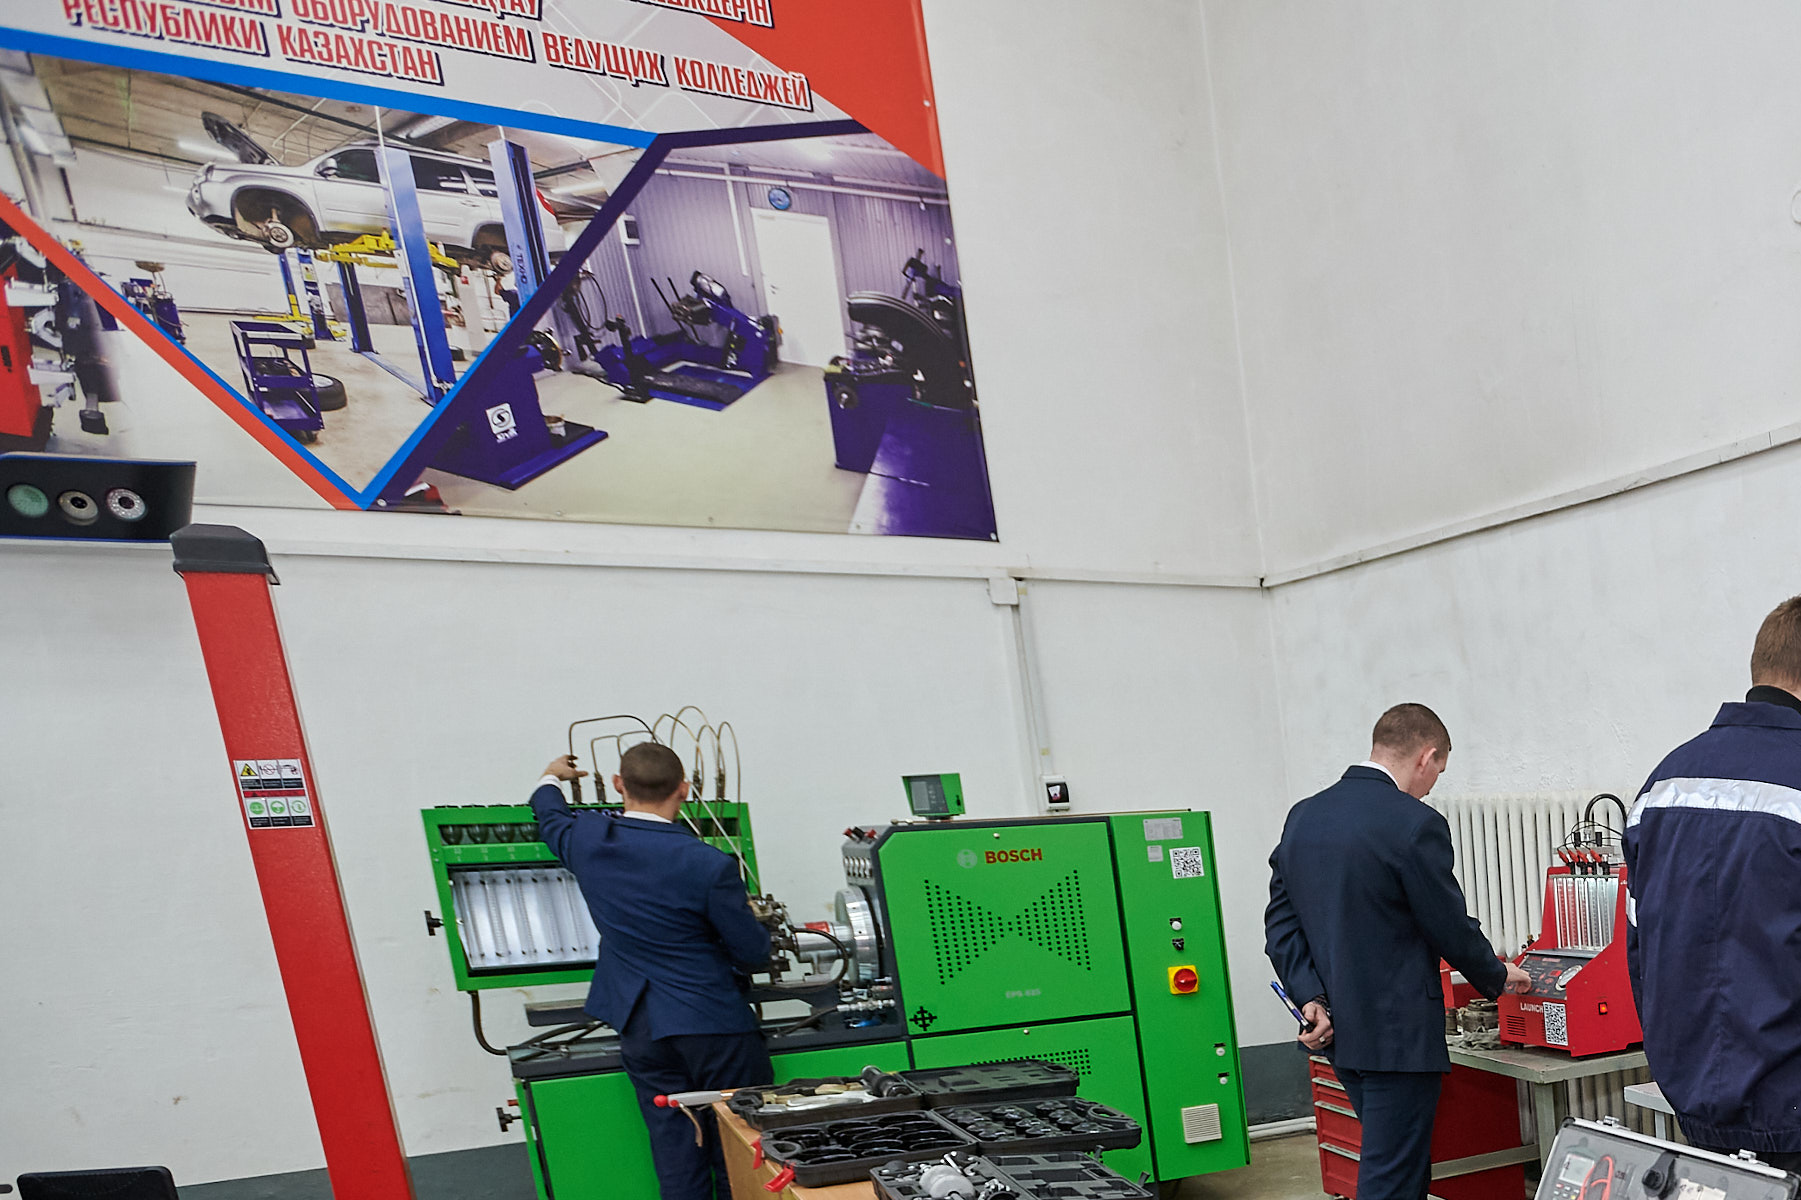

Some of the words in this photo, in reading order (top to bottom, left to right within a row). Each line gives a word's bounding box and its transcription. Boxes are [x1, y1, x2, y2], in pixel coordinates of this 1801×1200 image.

[62, 0, 264, 52] РЕСПУБЛИКИ
[276, 24, 438, 81] КАЗАХСТАН
[290, 0, 530, 58] ОБОРУДОВАНИЕМ
[542, 31, 664, 82] ВЕДУЩИХ
[674, 56, 811, 108] КОЛЛЕДЖЕЙ
[984, 848, 1043, 864] BOSCH
[1520, 1002, 1544, 1014] LAUNCH
